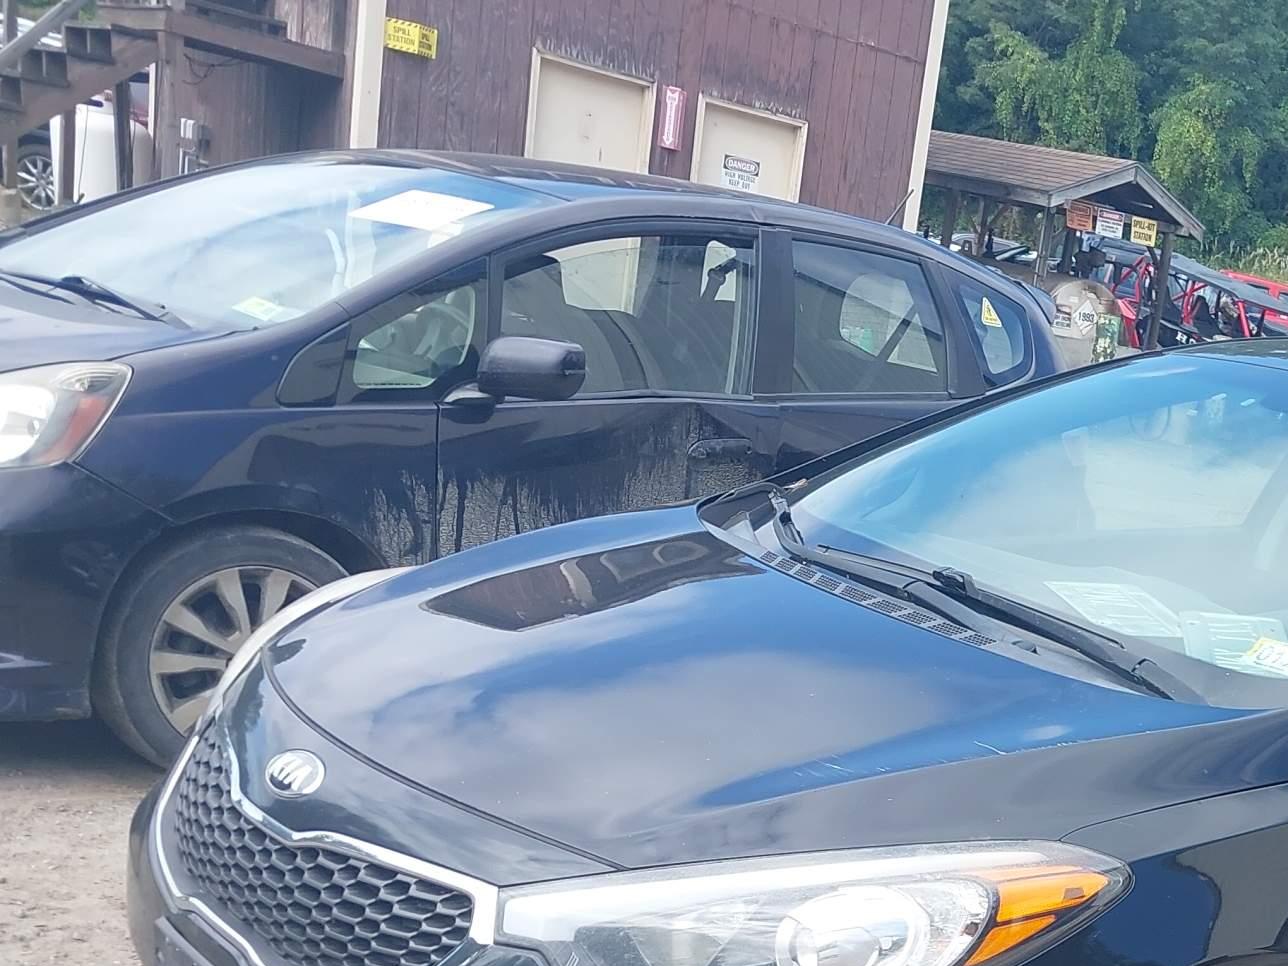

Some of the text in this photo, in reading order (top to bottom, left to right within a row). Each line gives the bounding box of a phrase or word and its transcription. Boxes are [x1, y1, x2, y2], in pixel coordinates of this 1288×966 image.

[393, 25, 411, 37] SPILL
[387, 33, 416, 46] STATION
[728, 159, 756, 172] DANGER
[1078, 312, 1095, 323] 1993
